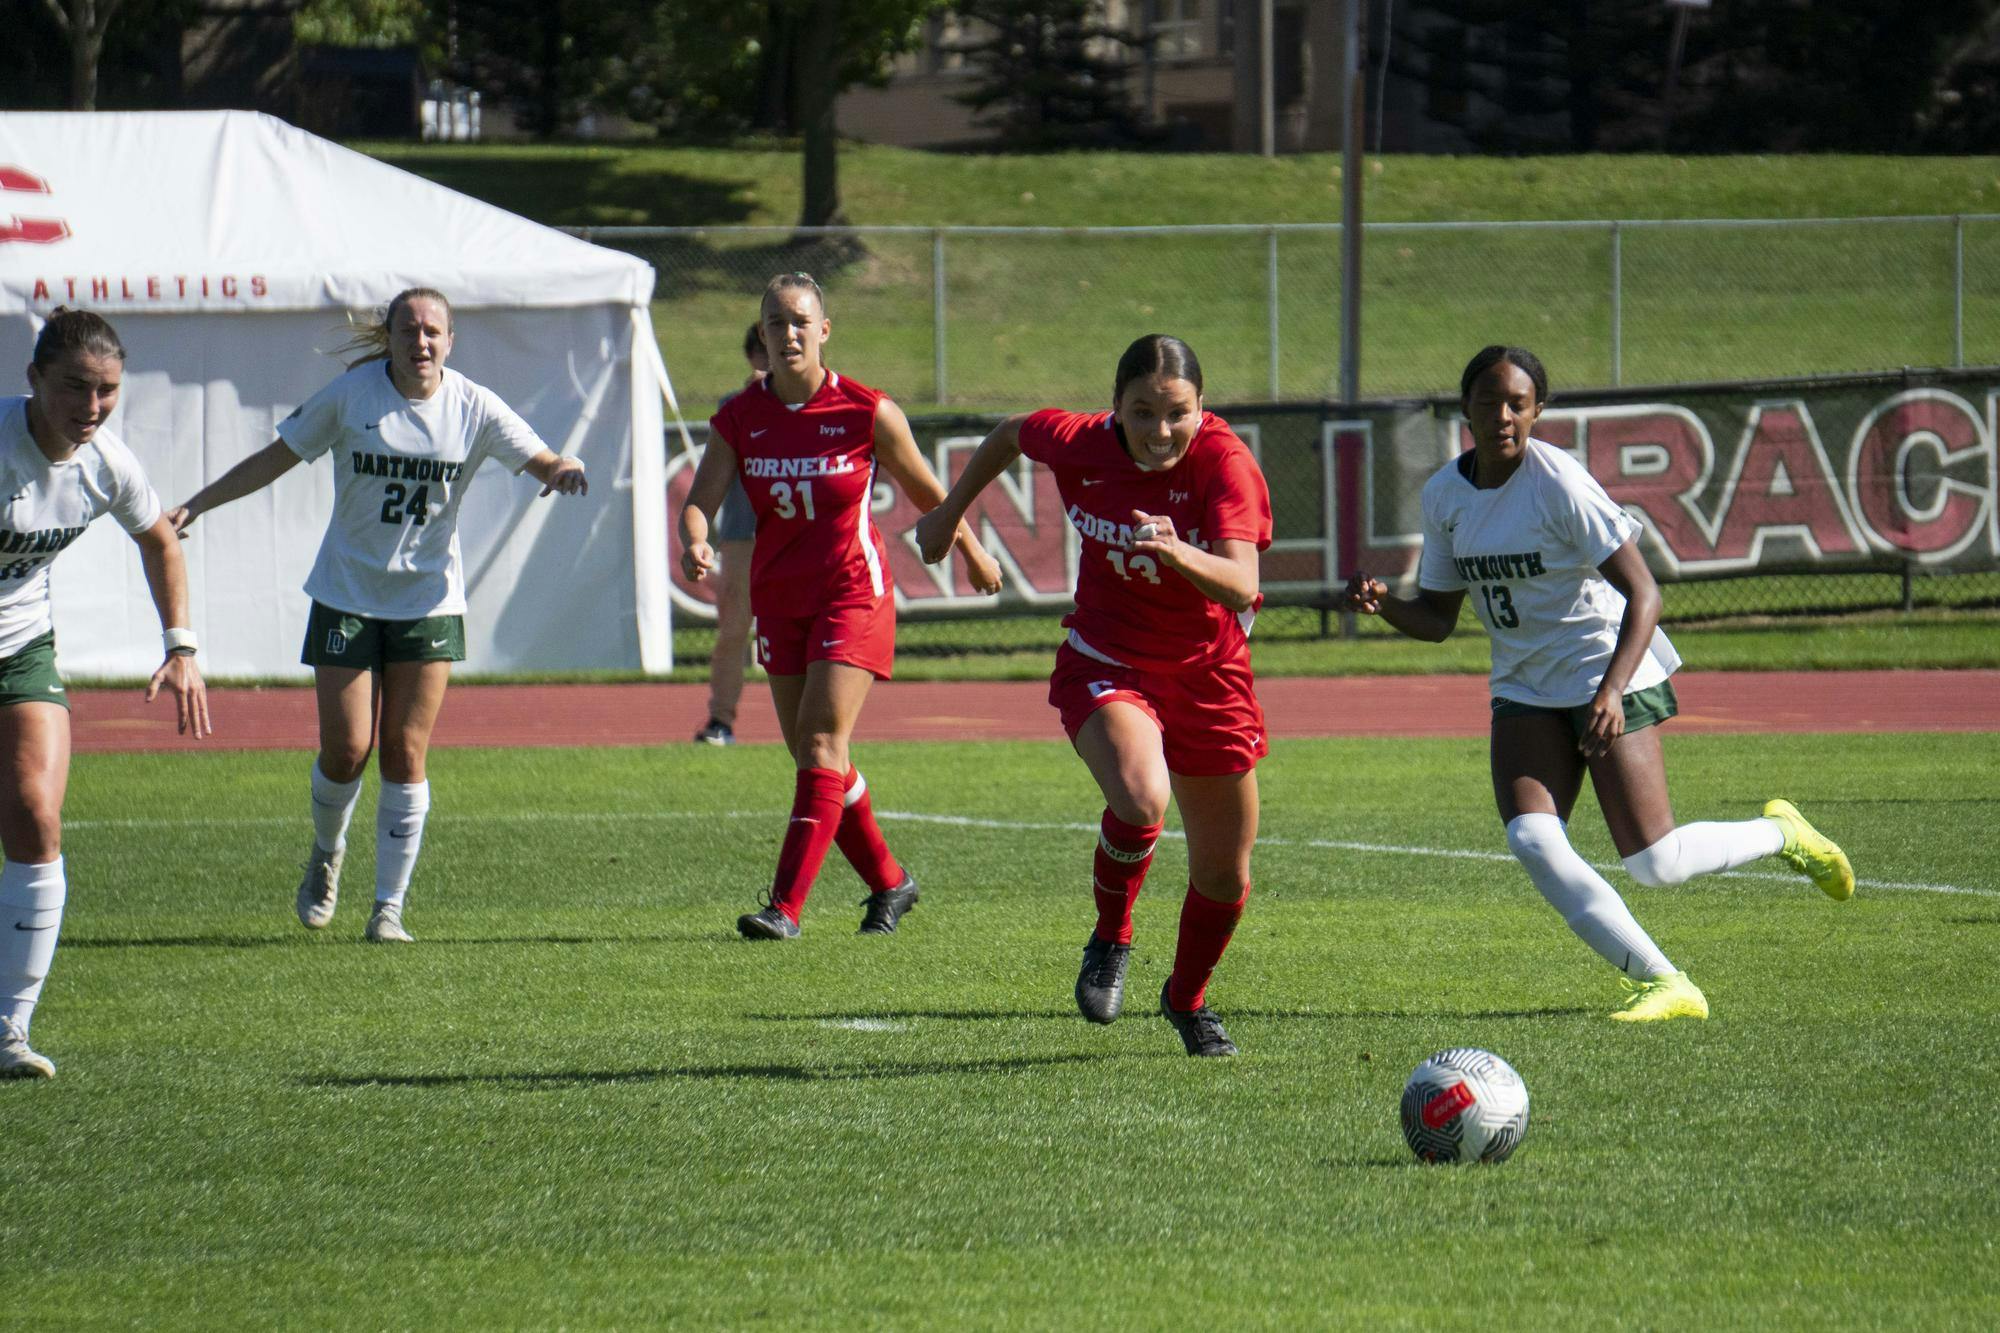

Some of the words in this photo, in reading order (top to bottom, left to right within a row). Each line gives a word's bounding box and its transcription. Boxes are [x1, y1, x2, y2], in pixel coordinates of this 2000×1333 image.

[33, 274, 269, 300] ATHLETICS
[352, 451, 465, 482] DARTMOUTH
[744, 454, 854, 477] CORNELL
[1450, 388, 2000, 577] RAC
[380, 482, 429, 525] 24
[770, 480, 815, 520] 31
[1068, 503, 1209, 551] CORNL
[1106, 550, 1161, 584] 13
[1481, 584, 1520, 629] 13
[326, 629, 348, 654] D
